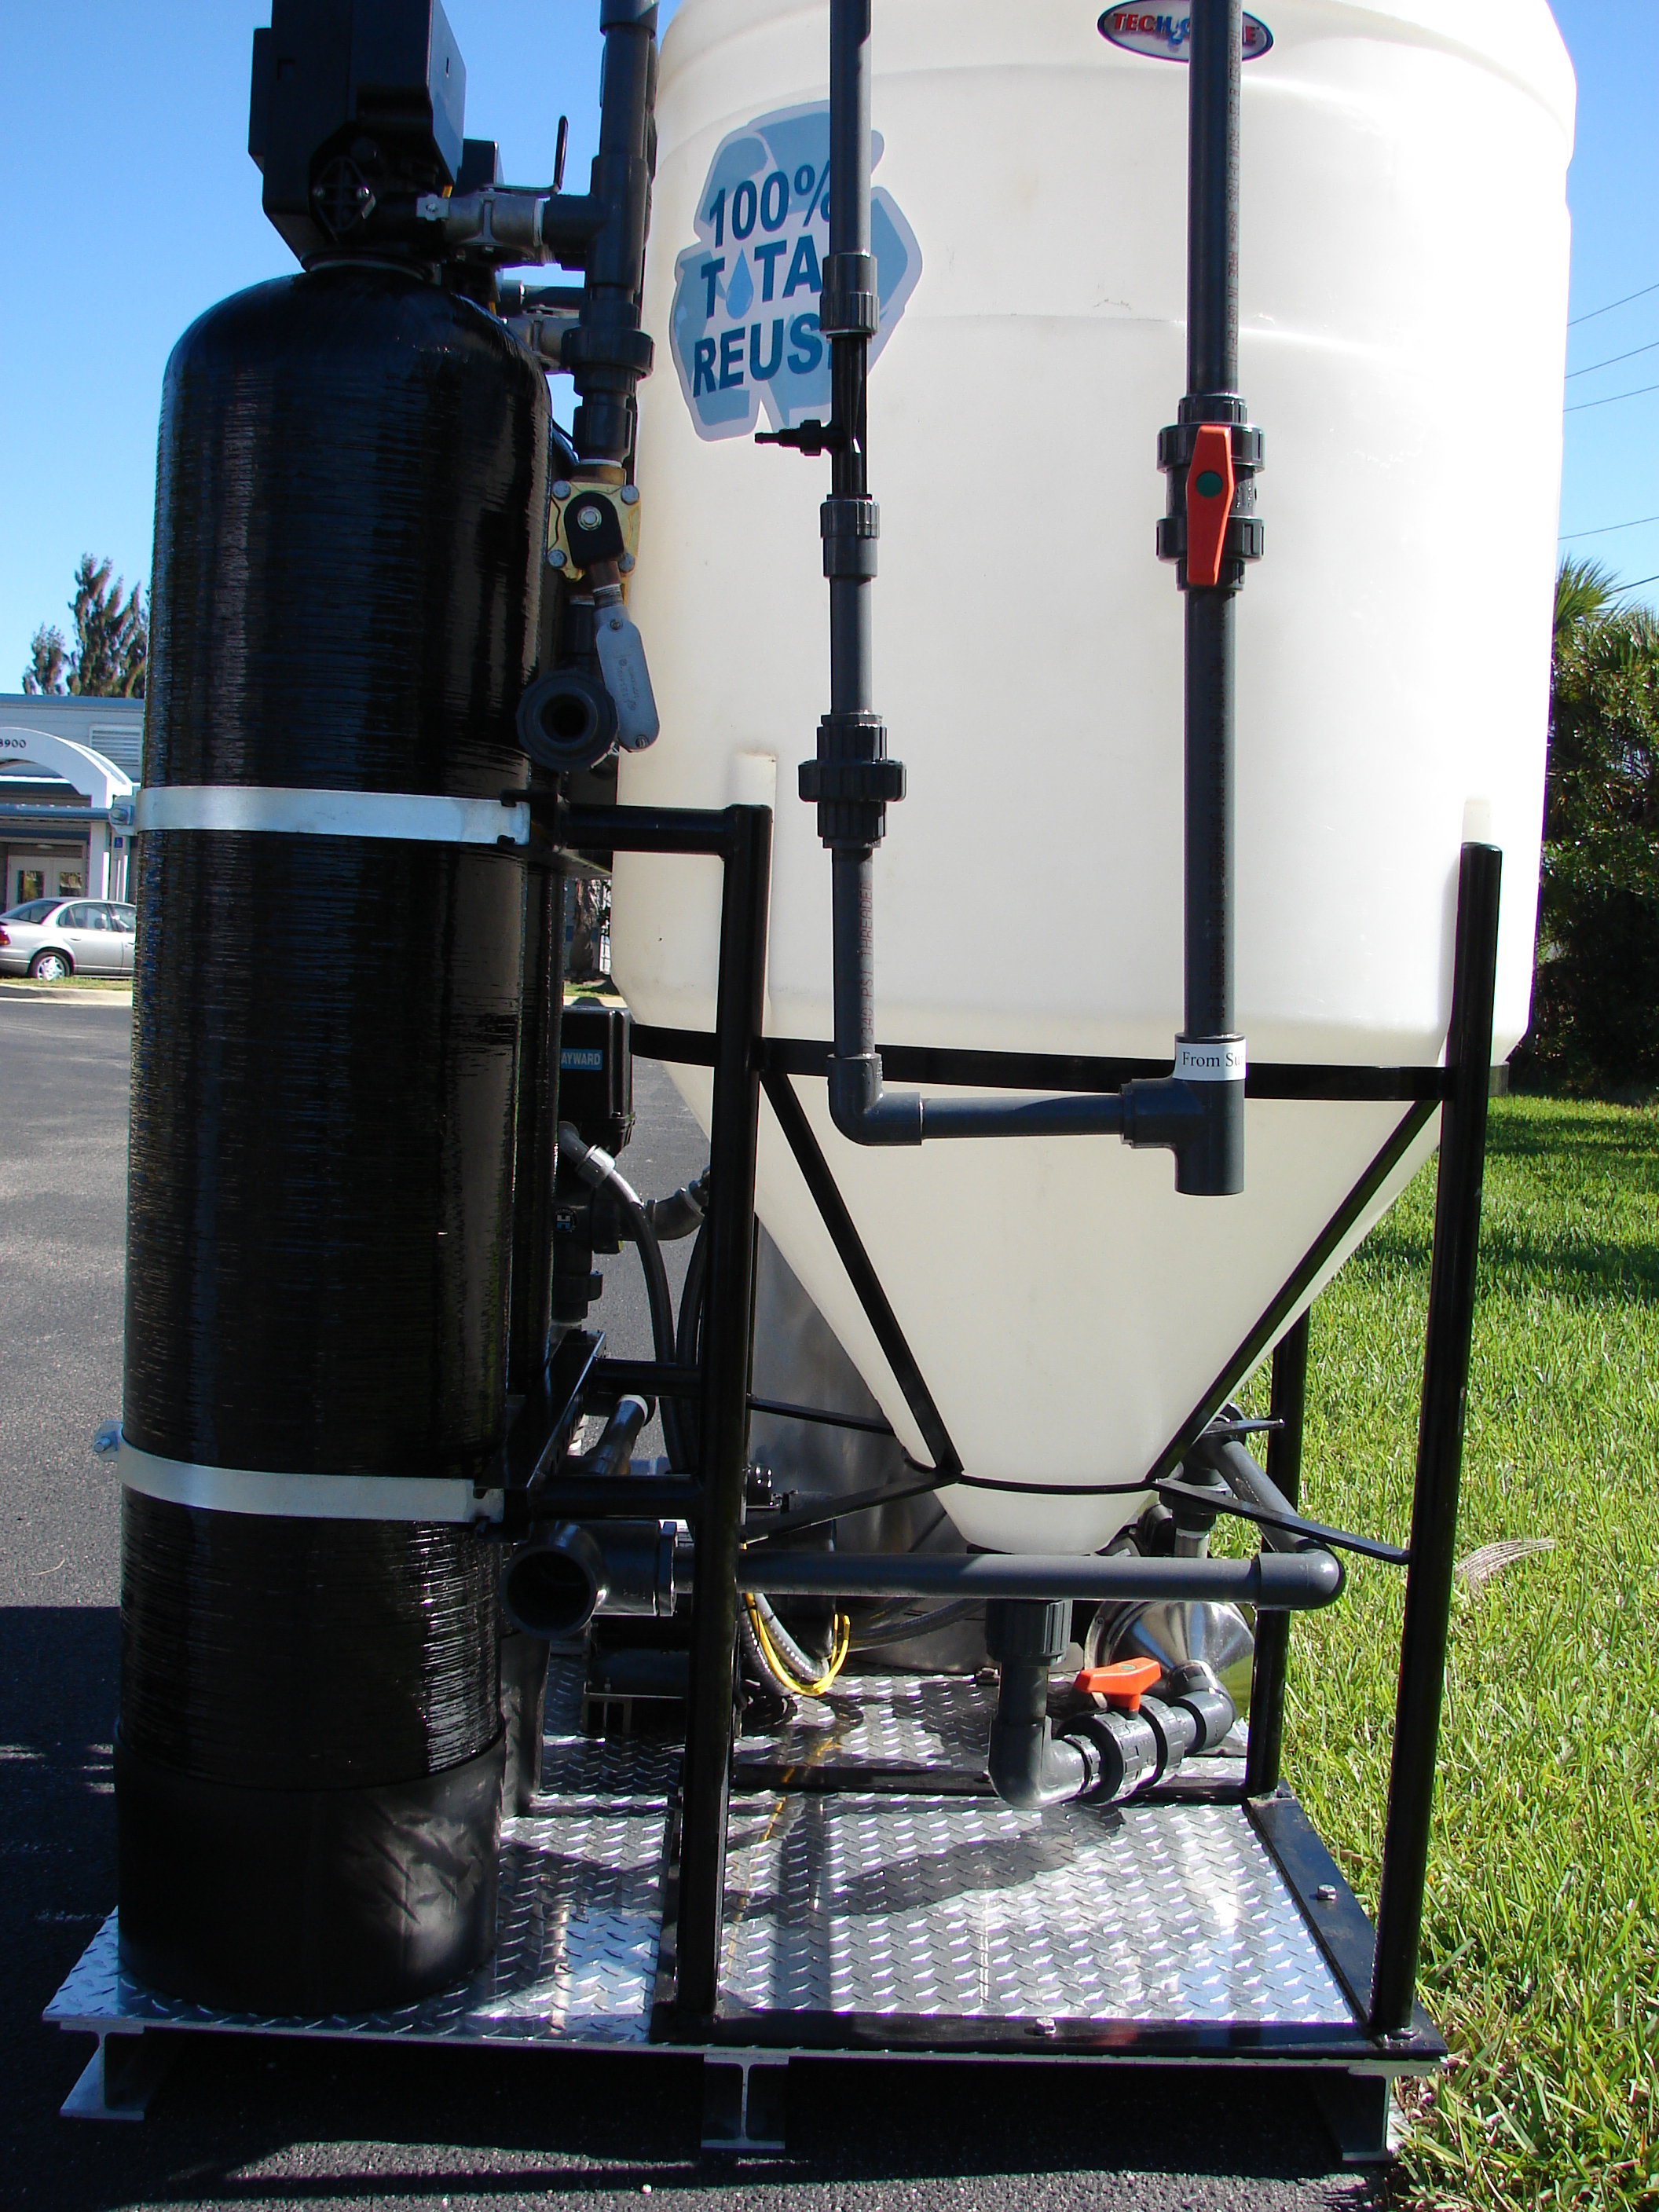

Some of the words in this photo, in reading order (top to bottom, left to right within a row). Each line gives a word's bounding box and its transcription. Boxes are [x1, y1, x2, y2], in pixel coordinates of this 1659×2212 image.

[709, 160, 831, 248] 100%
[701, 235, 823, 320] TOTA
[693, 312, 832, 397] REUS
[860, 969, 873, 997] PSI
[561, 1052, 601, 1066] AYWARD
[1182, 1051, 1221, 1068] From
